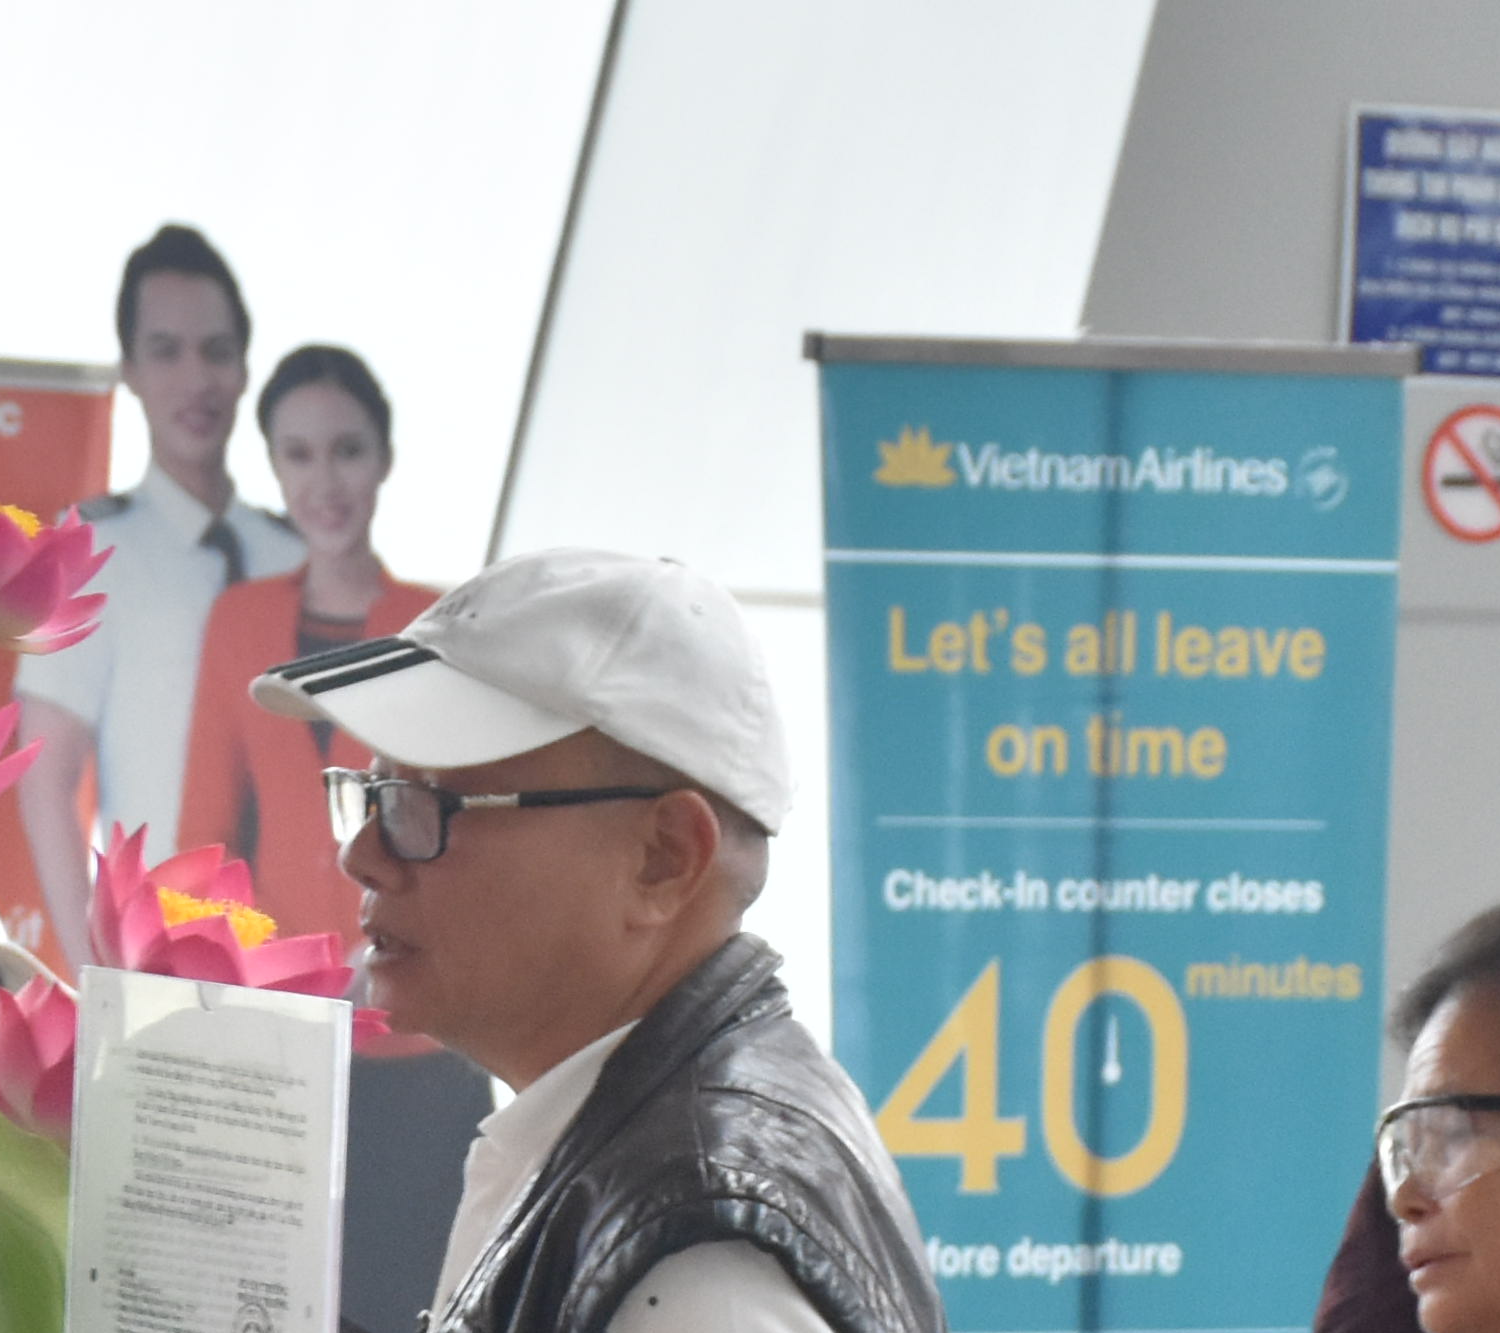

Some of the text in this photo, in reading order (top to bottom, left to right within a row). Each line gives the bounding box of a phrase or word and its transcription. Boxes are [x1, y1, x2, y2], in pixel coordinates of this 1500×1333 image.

[888, 605, 1327, 680] Let's all leave
[986, 709, 1228, 778] on time
[1057, 871, 1199, 912] counter
[1206, 874, 1325, 914] closes
[874, 954, 1364, 1198] 40 minutes
[925, 1236, 1183, 1285] fore departure
